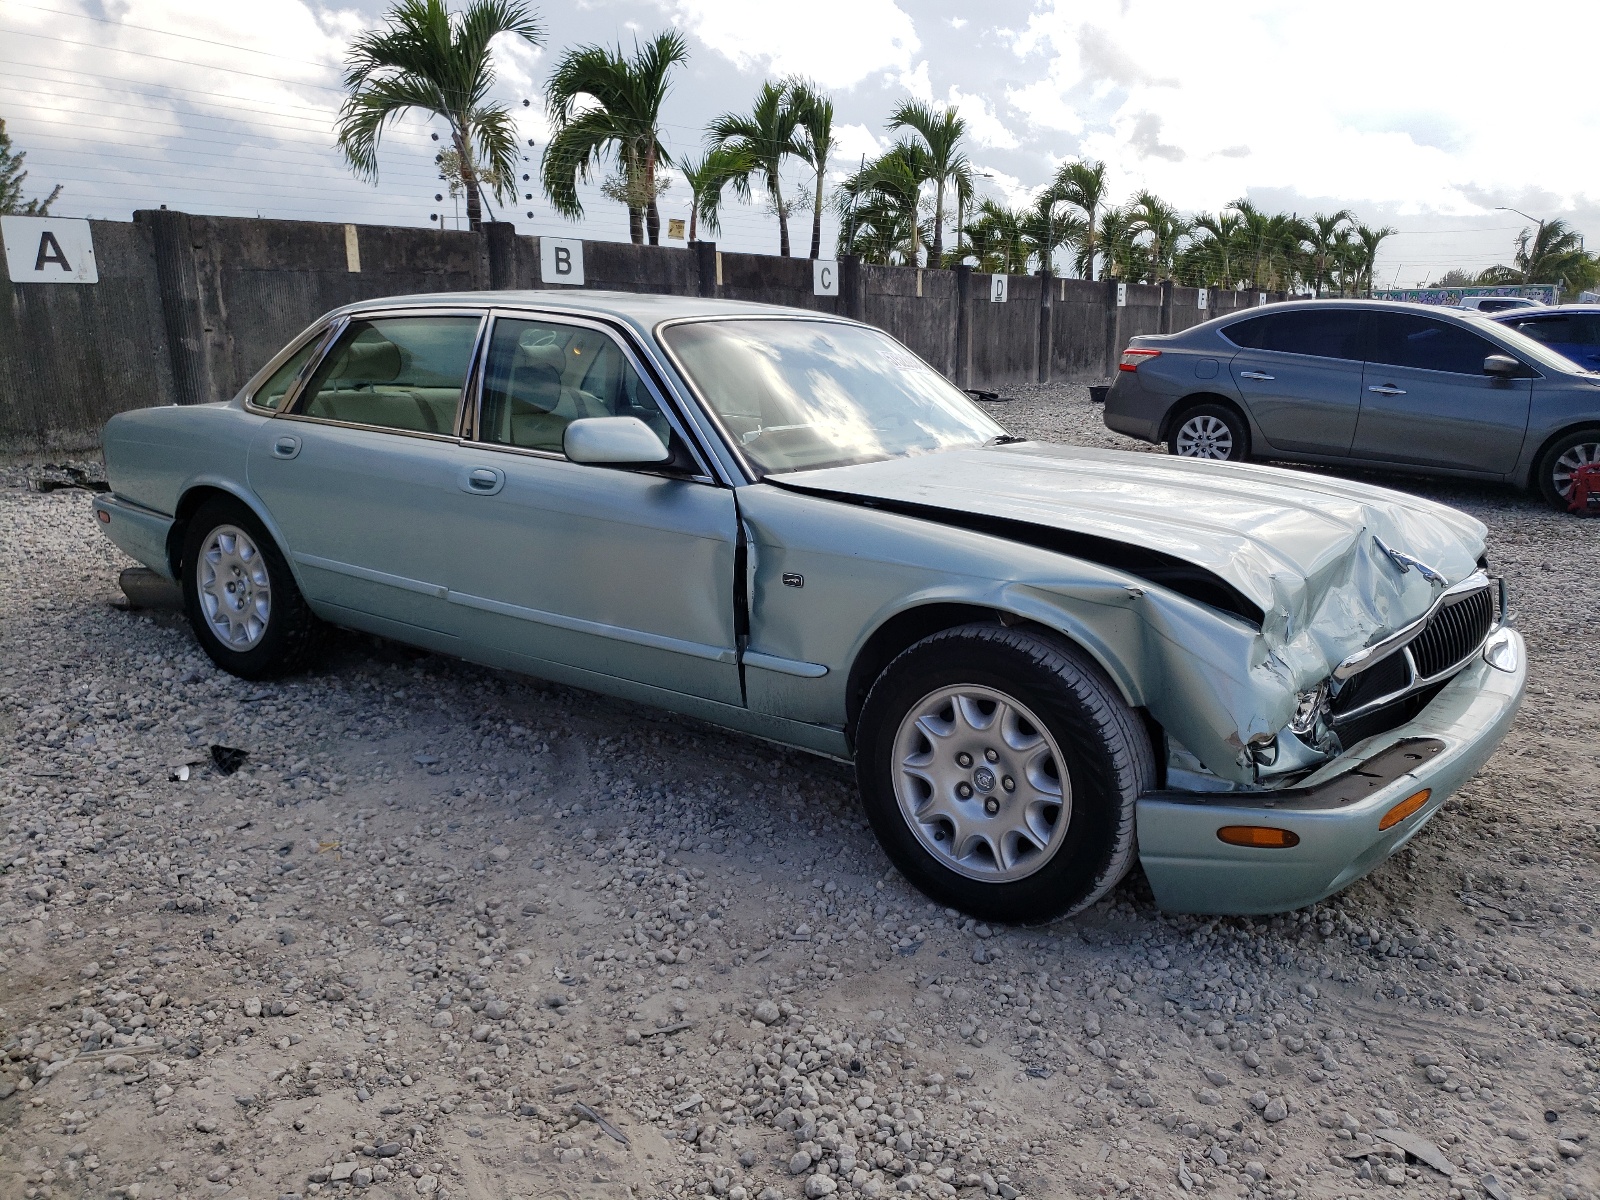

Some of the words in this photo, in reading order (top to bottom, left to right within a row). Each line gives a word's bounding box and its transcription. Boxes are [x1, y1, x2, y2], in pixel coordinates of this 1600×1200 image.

[34, 231, 72, 272] A
[554, 246, 572, 275] B
[821, 267, 831, 290] C
[997, 280, 1003, 296] D
